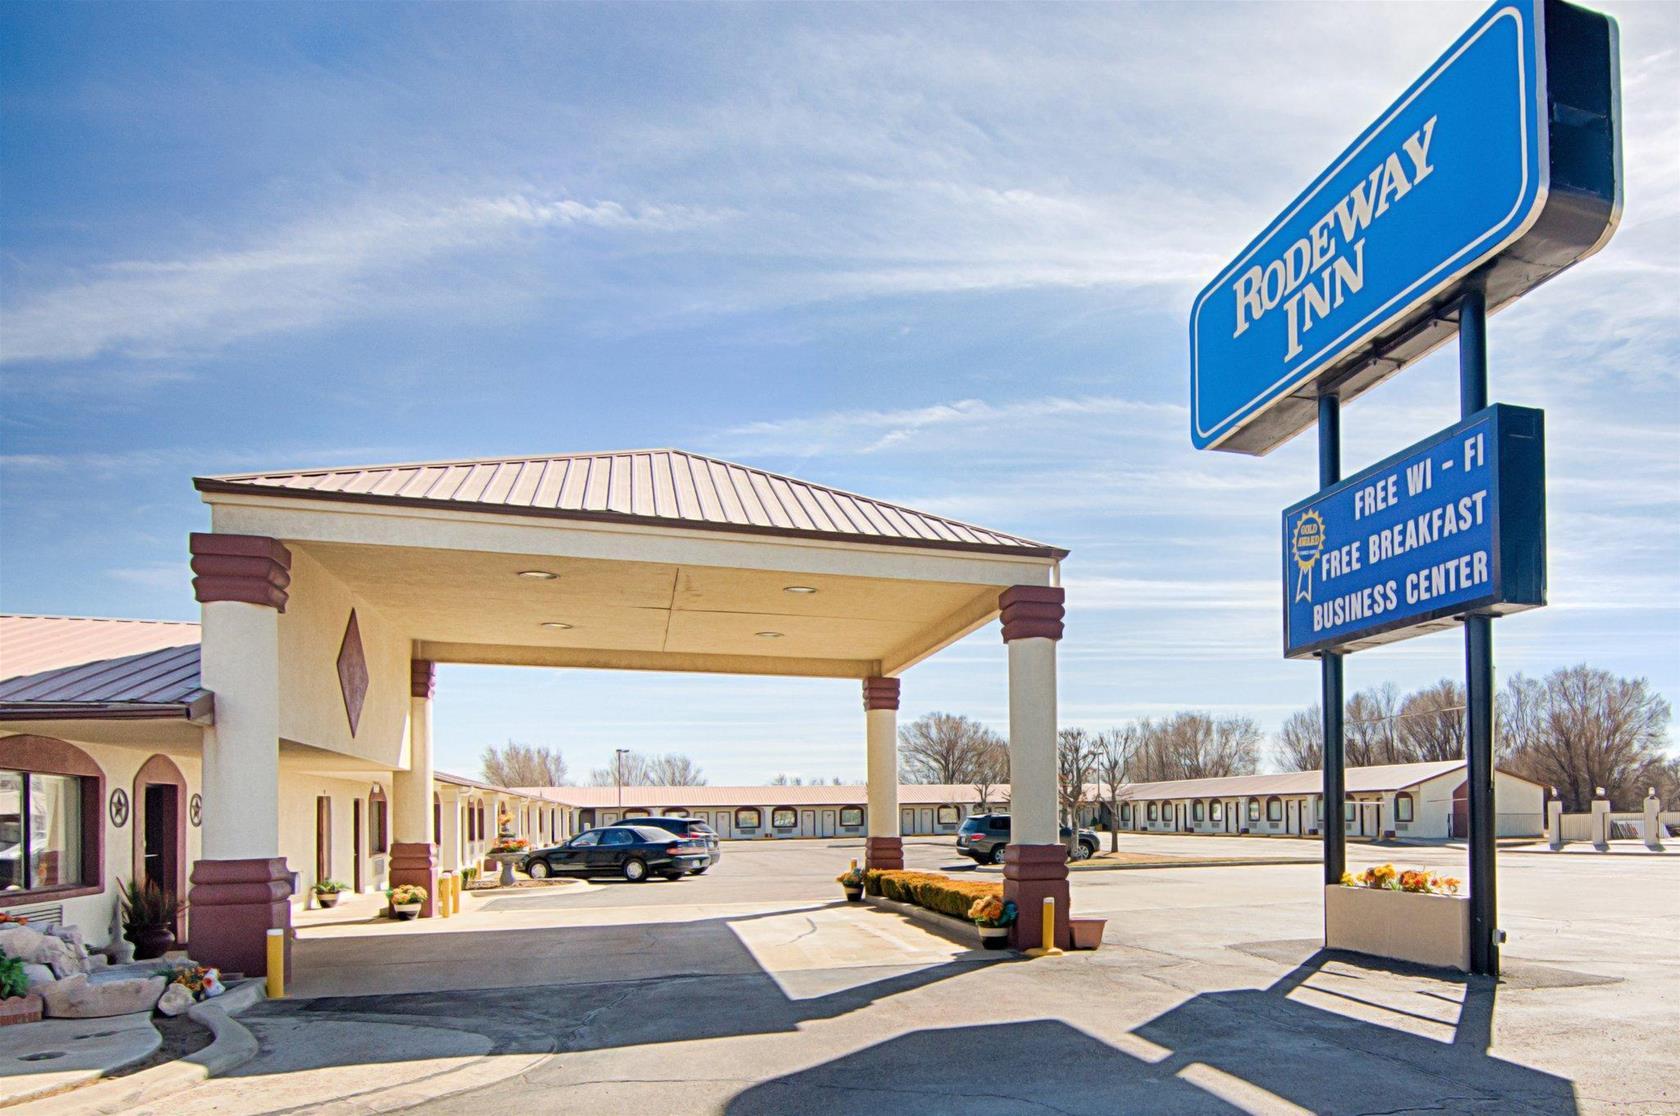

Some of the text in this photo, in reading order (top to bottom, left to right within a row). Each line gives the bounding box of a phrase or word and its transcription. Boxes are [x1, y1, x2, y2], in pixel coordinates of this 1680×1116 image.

[1233, 114, 1438, 339] RODEWAY
[1283, 237, 1366, 363] INN
[1354, 474, 1398, 520] FREE
[1406, 458, 1432, 496] WI
[1464, 433, 1484, 472] FI
[1321, 490, 1487, 582] FREE BREAKFAST
[1313, 550, 1488, 632] BUSINESS CENTER
